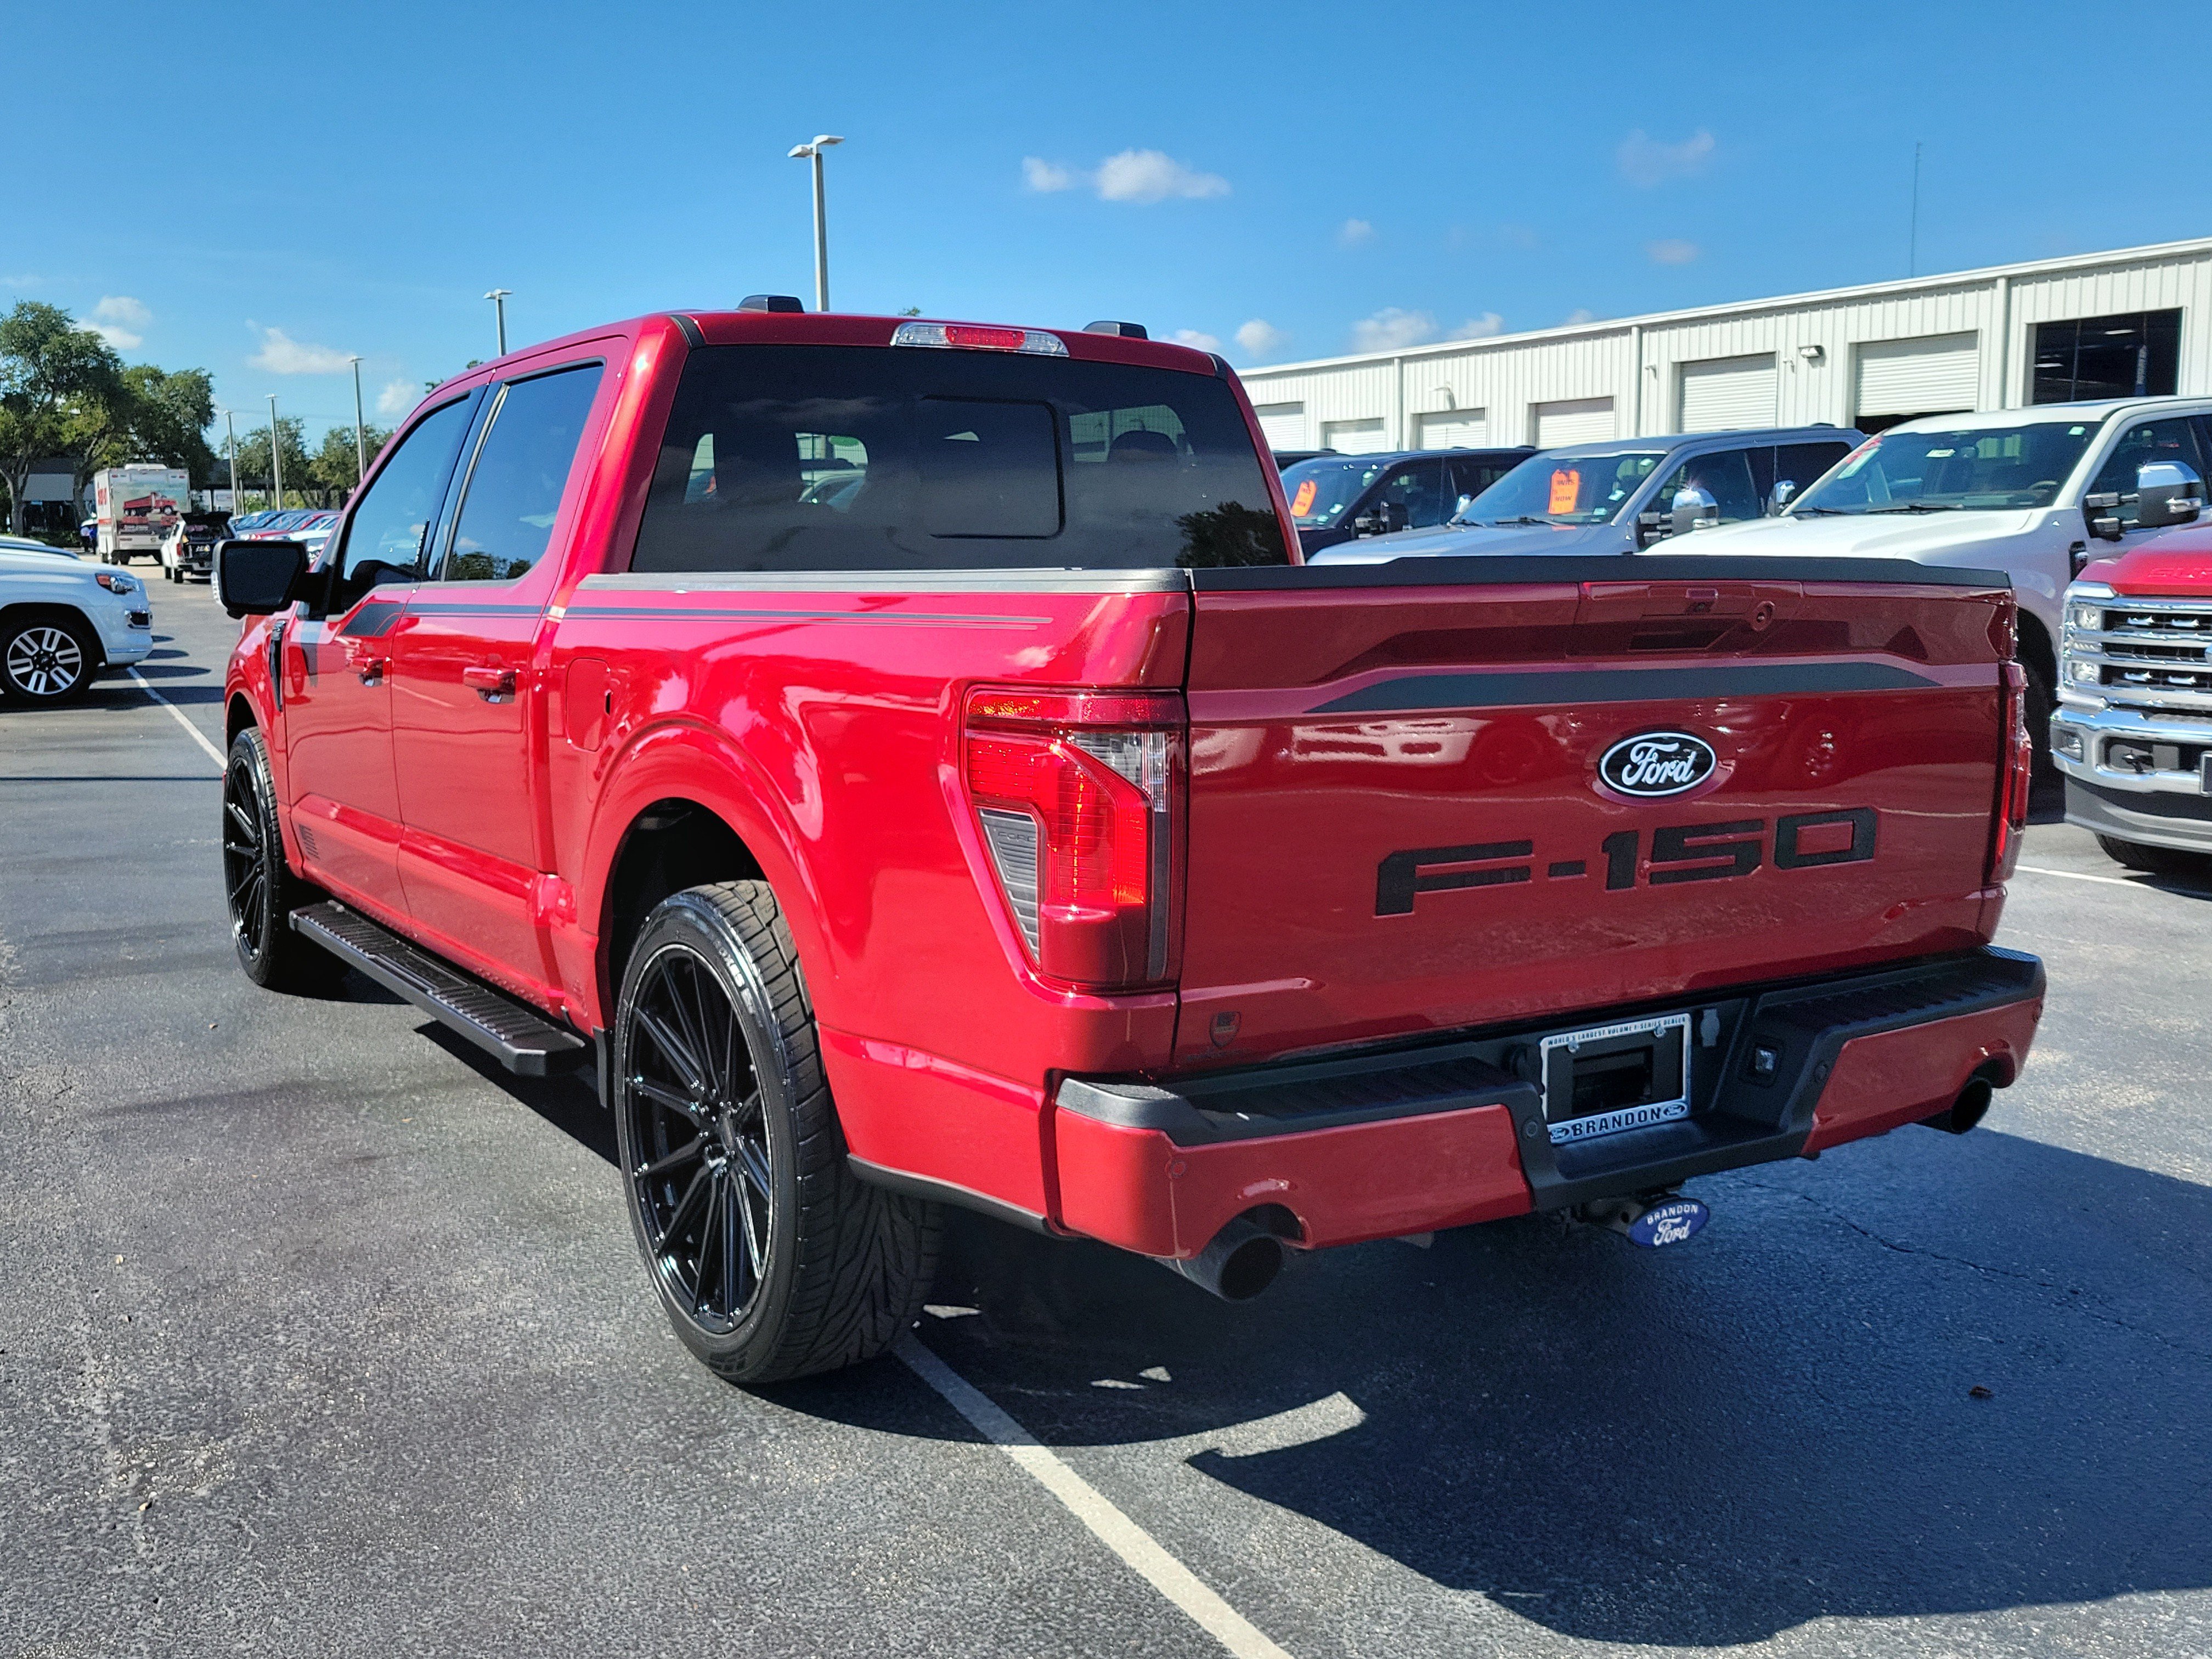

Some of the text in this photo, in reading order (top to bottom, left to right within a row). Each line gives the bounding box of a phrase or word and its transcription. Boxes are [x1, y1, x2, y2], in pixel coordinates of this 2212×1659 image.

[1622, 742, 1697, 786] Ford
[998, 832, 1036, 843] FORD
[1374, 806, 1877, 917] F-150
[1578, 1030, 1606, 1041] LARGEST
[1607, 1026, 1632, 1036] VOLUME
[1634, 1020, 1661, 1031] F-SERIES
[1663, 1016, 1686, 1026] DEALER
[1571, 1107, 1661, 1137] BRANDON
[1646, 1204, 1699, 1226] BRANDON
[1654, 1216, 1691, 1246] Ford
